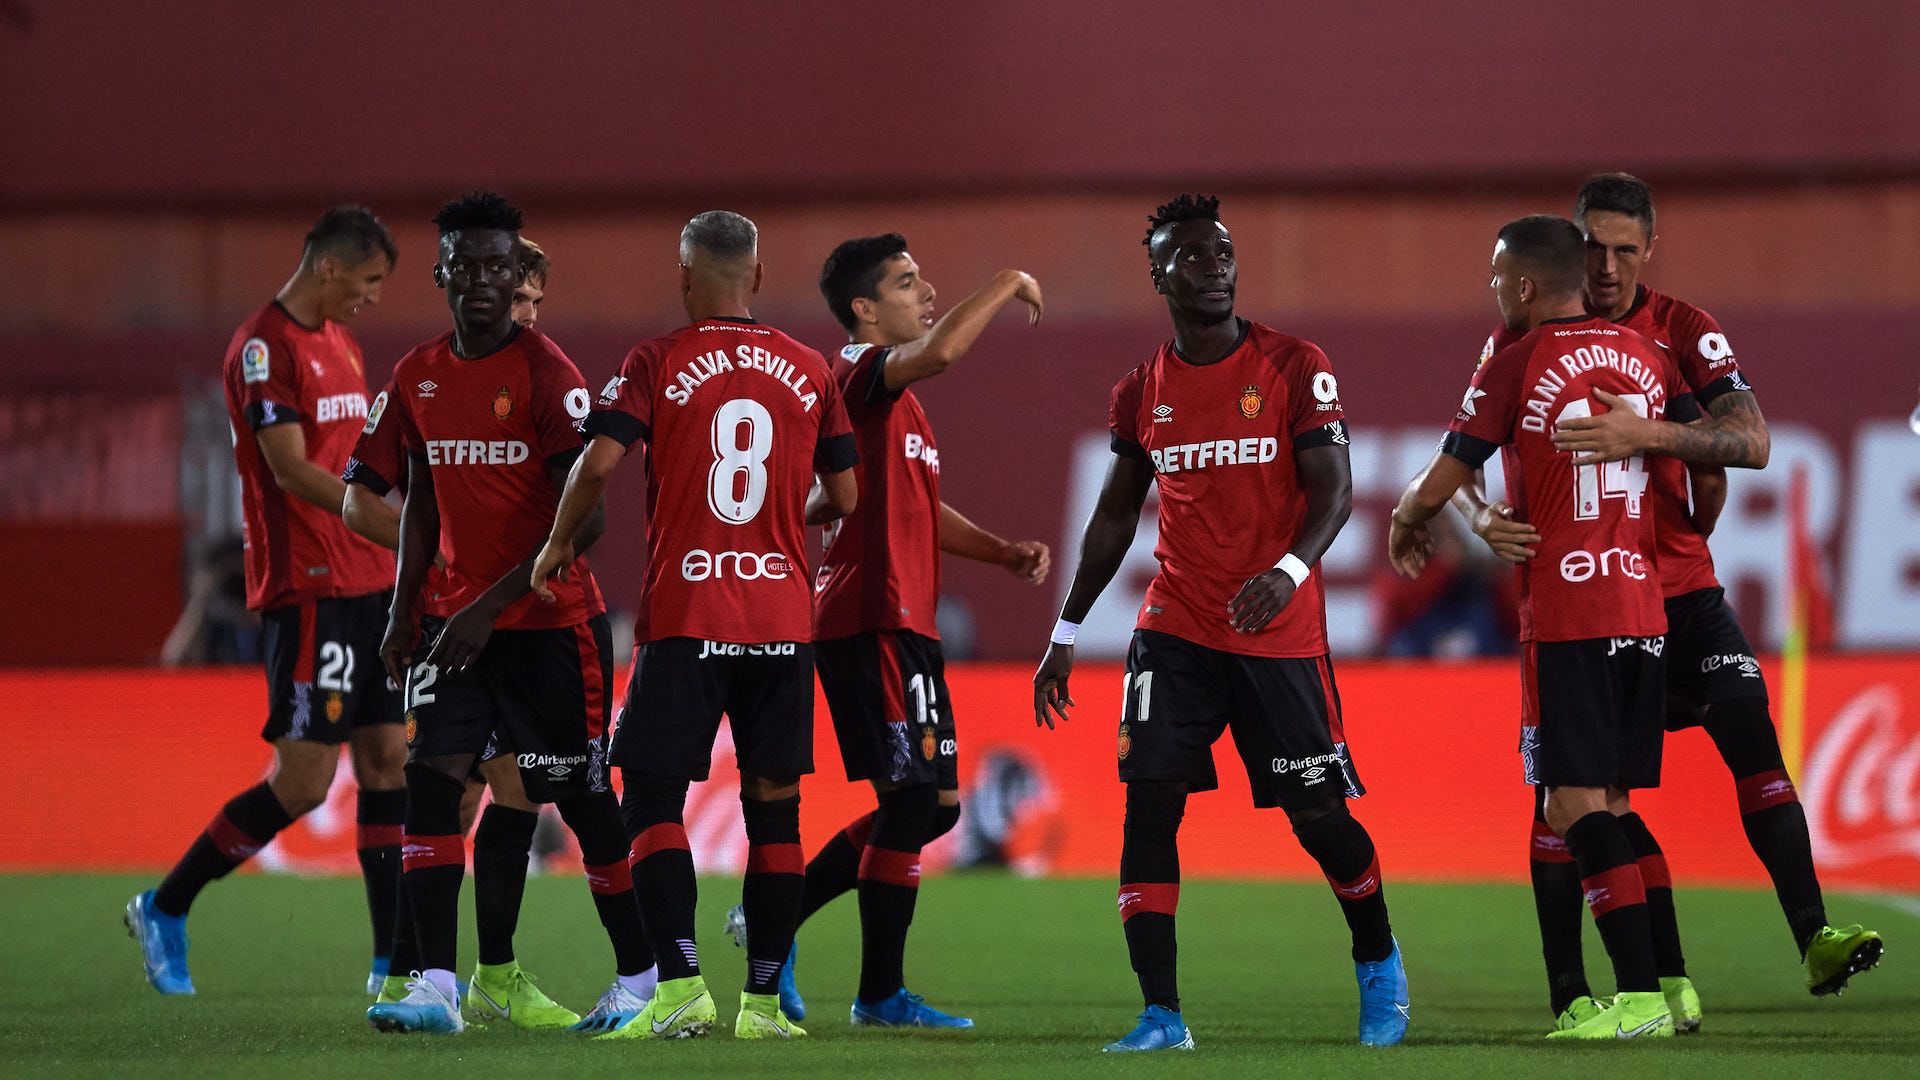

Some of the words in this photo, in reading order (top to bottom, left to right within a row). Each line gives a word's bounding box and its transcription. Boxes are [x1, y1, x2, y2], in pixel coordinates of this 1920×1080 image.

[665, 350, 734, 407] SALVA
[736, 344, 817, 413] SEVILLA
[1522, 368, 1566, 433] DANI
[1558, 344, 1666, 421] RODRIGUEZ
[1154, 416, 1173, 424] umbro
[1316, 403, 1334, 412] RENT
[1456, 411, 1470, 422] CAR
[426, 439, 529, 466] ETFRED
[707, 398, 773, 525] 8
[1150, 436, 1278, 474] BETFRED
[1550, 394, 1649, 521] 14
[767, 562, 794, 572] HOTELS
[1121, 670, 1154, 723] 11
[537, 754, 587, 766] AirEuropa
[1304, 776, 1326, 787] umbro
